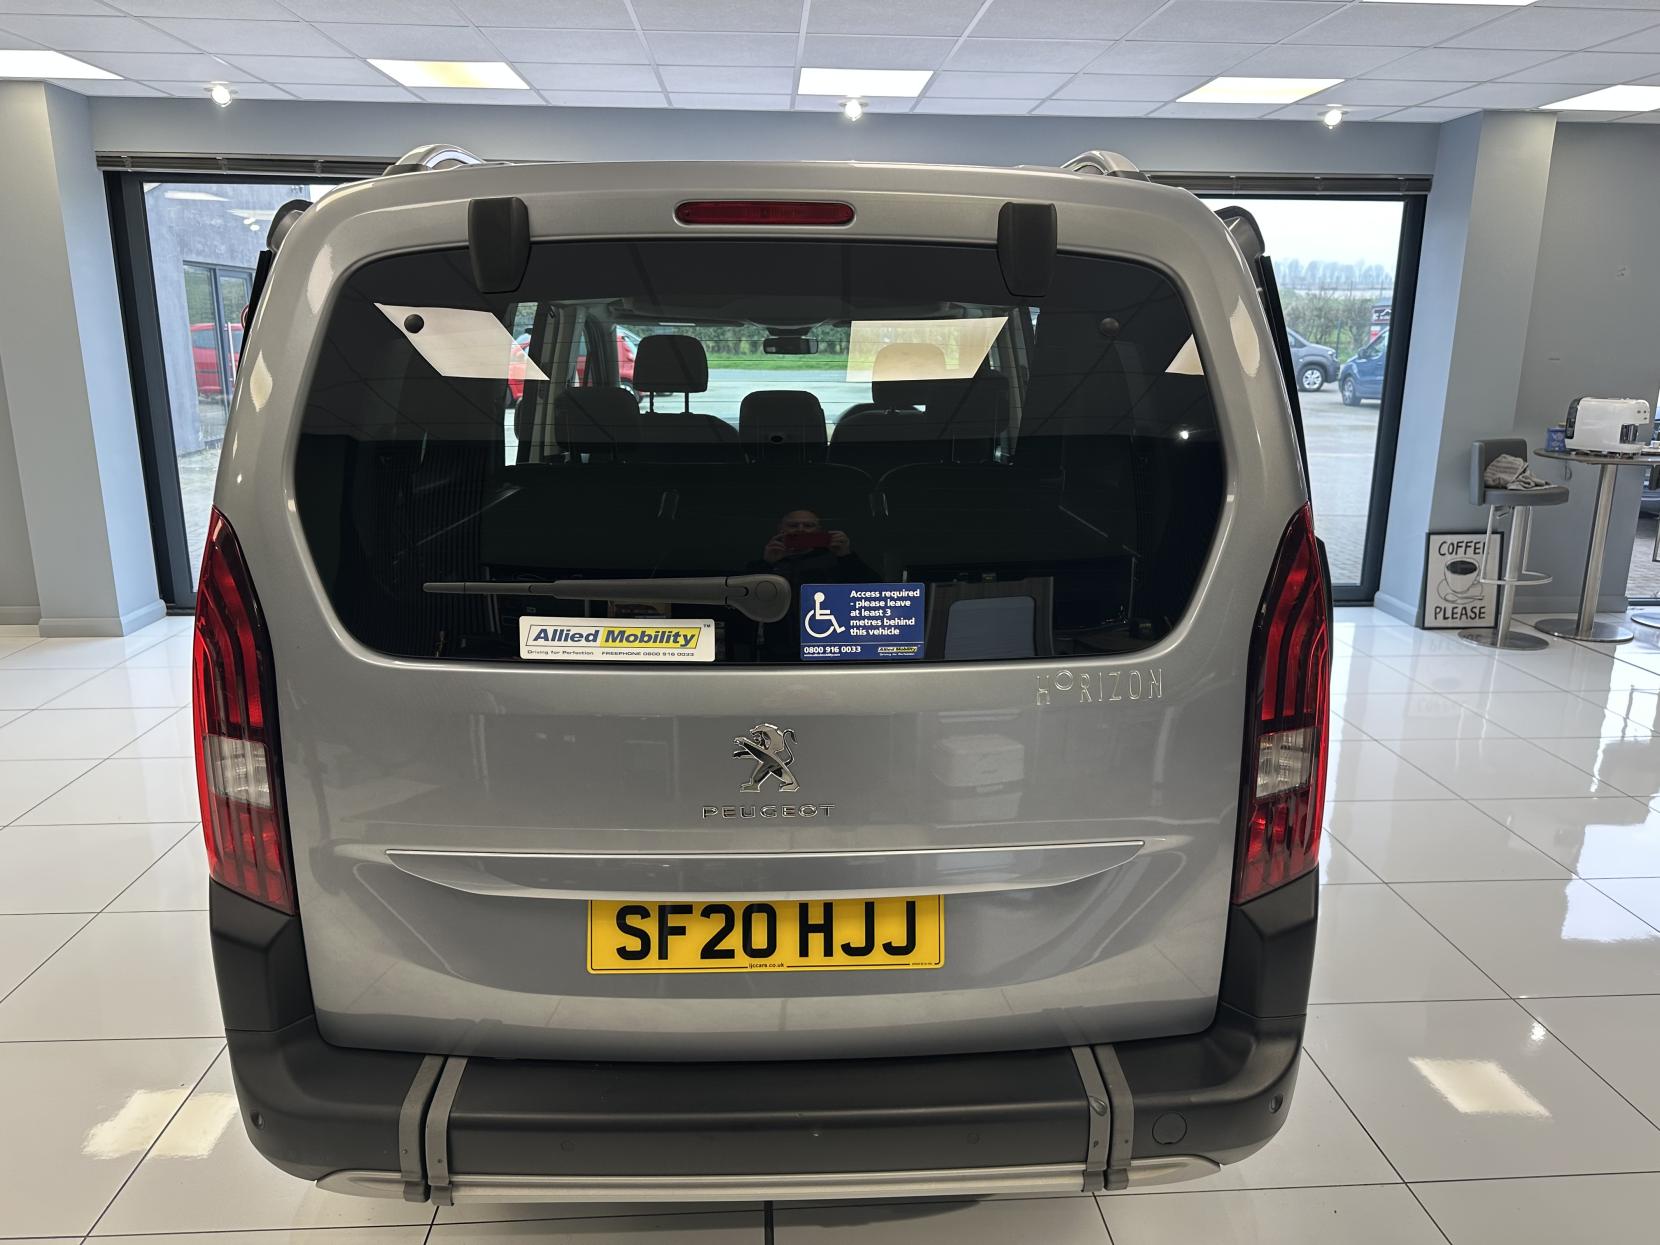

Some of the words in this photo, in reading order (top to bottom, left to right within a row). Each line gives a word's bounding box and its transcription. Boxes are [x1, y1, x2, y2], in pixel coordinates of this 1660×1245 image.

[882, 589, 920, 598] required
[856, 600, 885, 608] please
[1434, 606, 1486, 620] PLEASE
[533, 628, 600, 643] Allied
[604, 630, 696, 647] Mobility
[1035, 668, 1163, 706] HORIZON
[702, 804, 836, 819] PEUGEOT
[616, 902, 777, 960] SF20
[798, 900, 917, 957] HJJ
